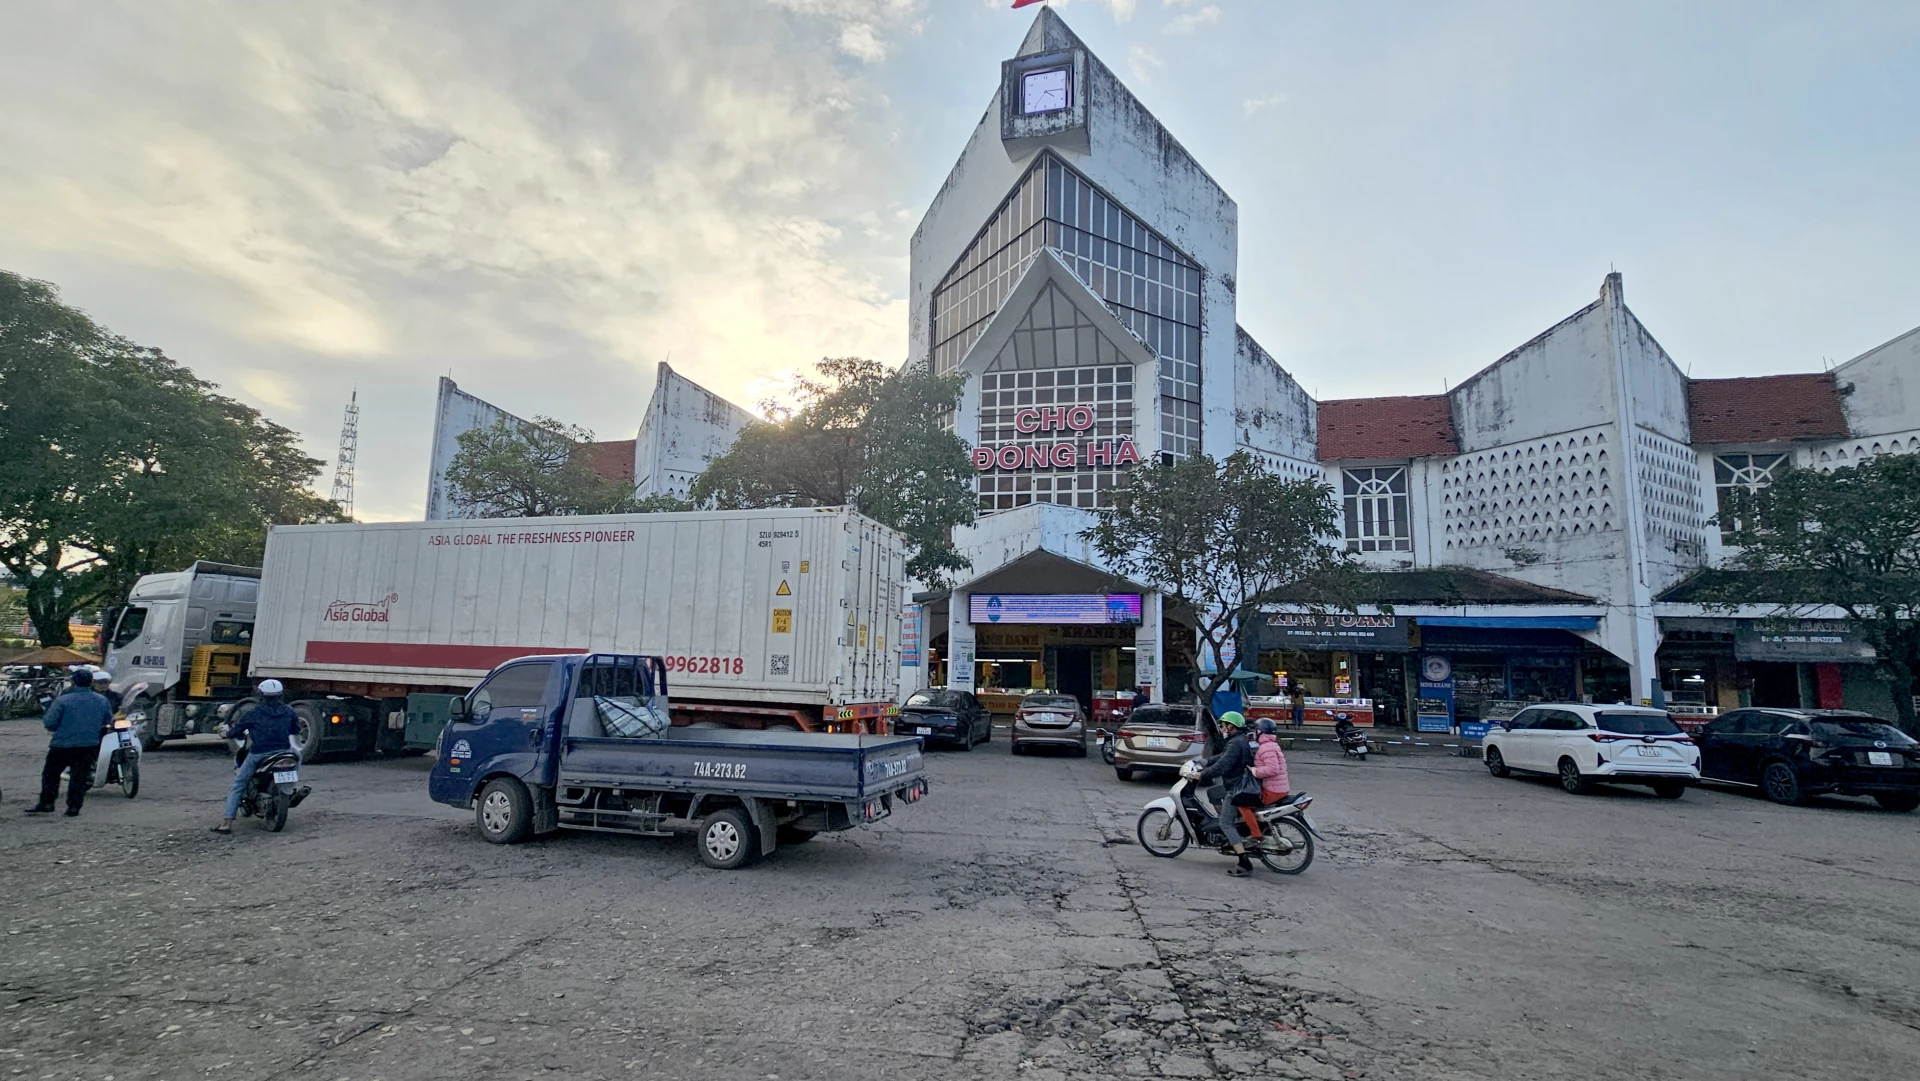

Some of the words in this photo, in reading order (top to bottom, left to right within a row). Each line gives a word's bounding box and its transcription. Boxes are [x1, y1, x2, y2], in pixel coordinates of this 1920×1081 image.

[1016, 403, 1094, 437] CHỢ
[971, 440, 1077, 471] ĐÔNG
[1087, 433, 1140, 466] HÀ
[428, 535, 450, 546] ASIA
[453, 534, 493, 545] GLOBAL
[497, 533, 516, 545] THE
[518, 531, 582, 544] FRESHNESS
[583, 530, 636, 543] PIONEER
[323, 607, 350, 622] Asia
[351, 607, 389, 622] Global
[645, 655, 744, 675] 9962818
[694, 761, 747, 779] 74A-273.82
